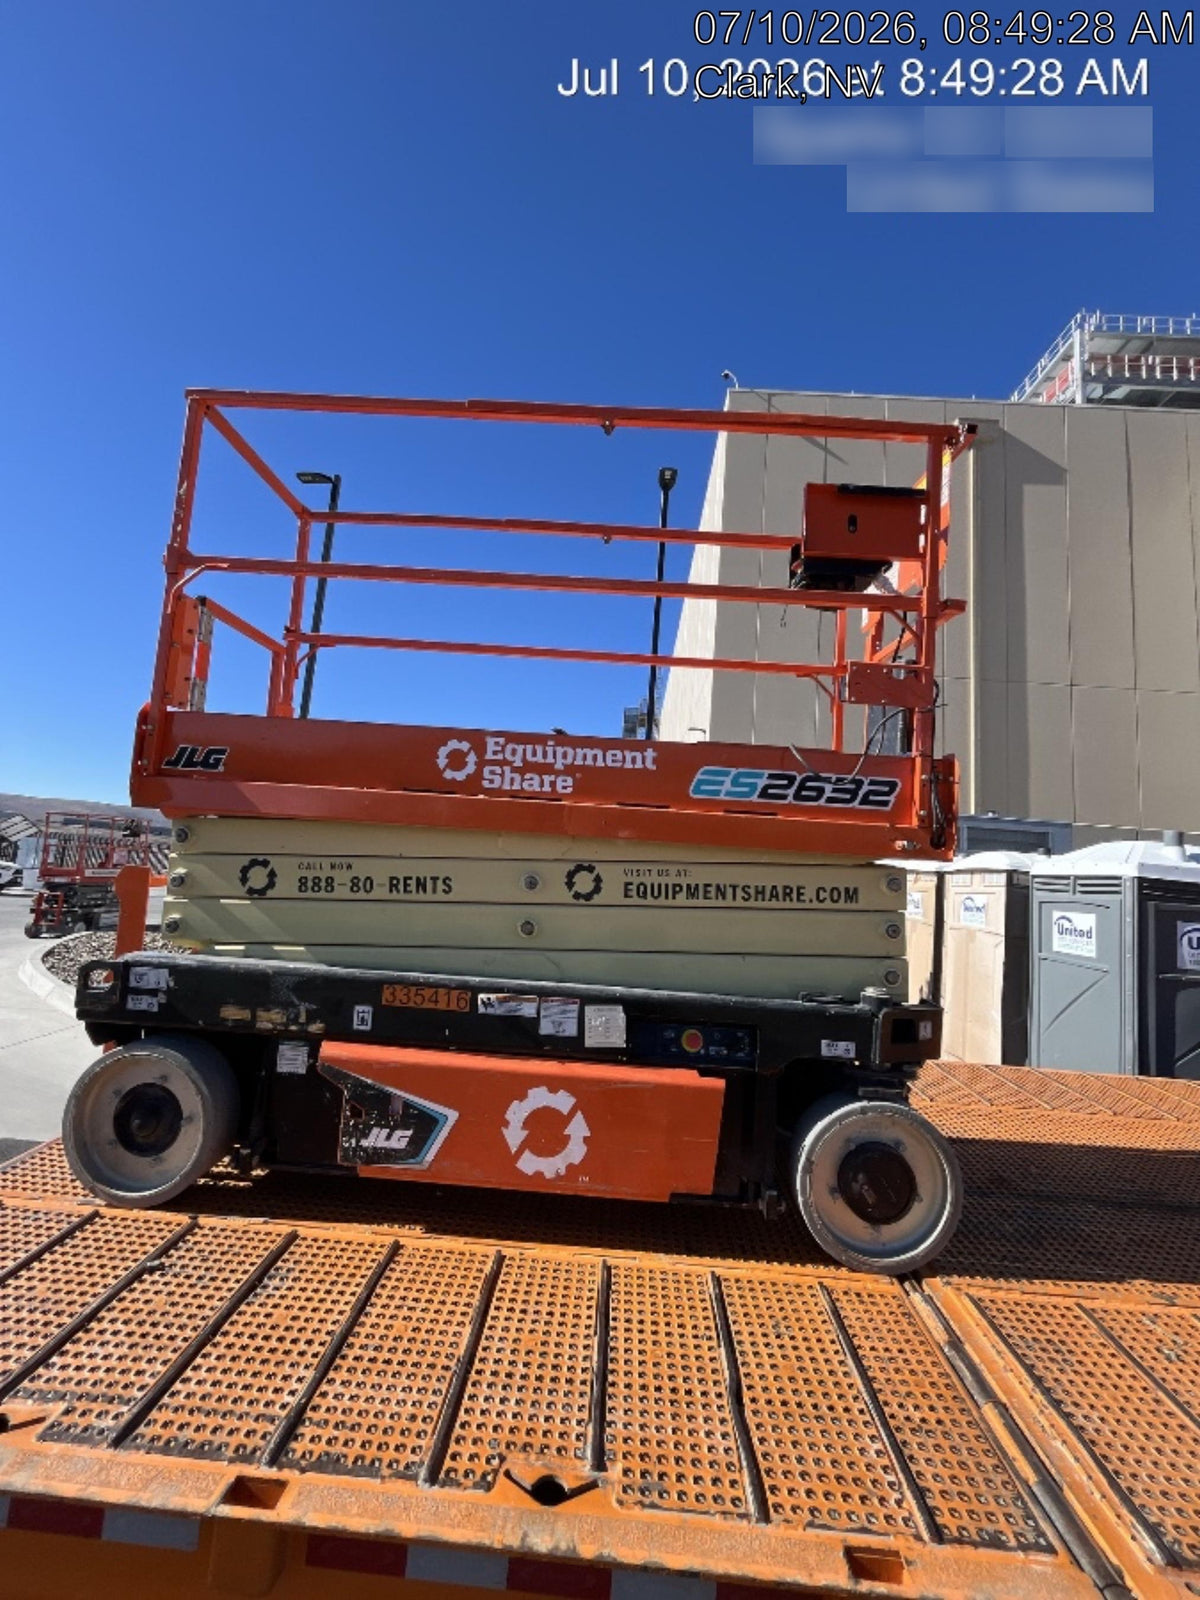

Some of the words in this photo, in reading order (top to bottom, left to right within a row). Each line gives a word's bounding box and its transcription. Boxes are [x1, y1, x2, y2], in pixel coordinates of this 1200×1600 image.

[163, 744, 230, 772] JLG
[484, 736, 658, 772] Equipment
[481, 766, 574, 795] Share
[298, 861, 323, 871] CALL
[623, 868, 652, 878] VISIT
[657, 868, 670, 878] US
[297, 875, 453, 895] 888-80-RENTS
[623, 881, 860, 905] EQUIPMENTSHARE.COM
[1057, 922, 1093, 940] United
[384, 985, 469, 1012] 335416
[360, 1127, 413, 1149] JLG
